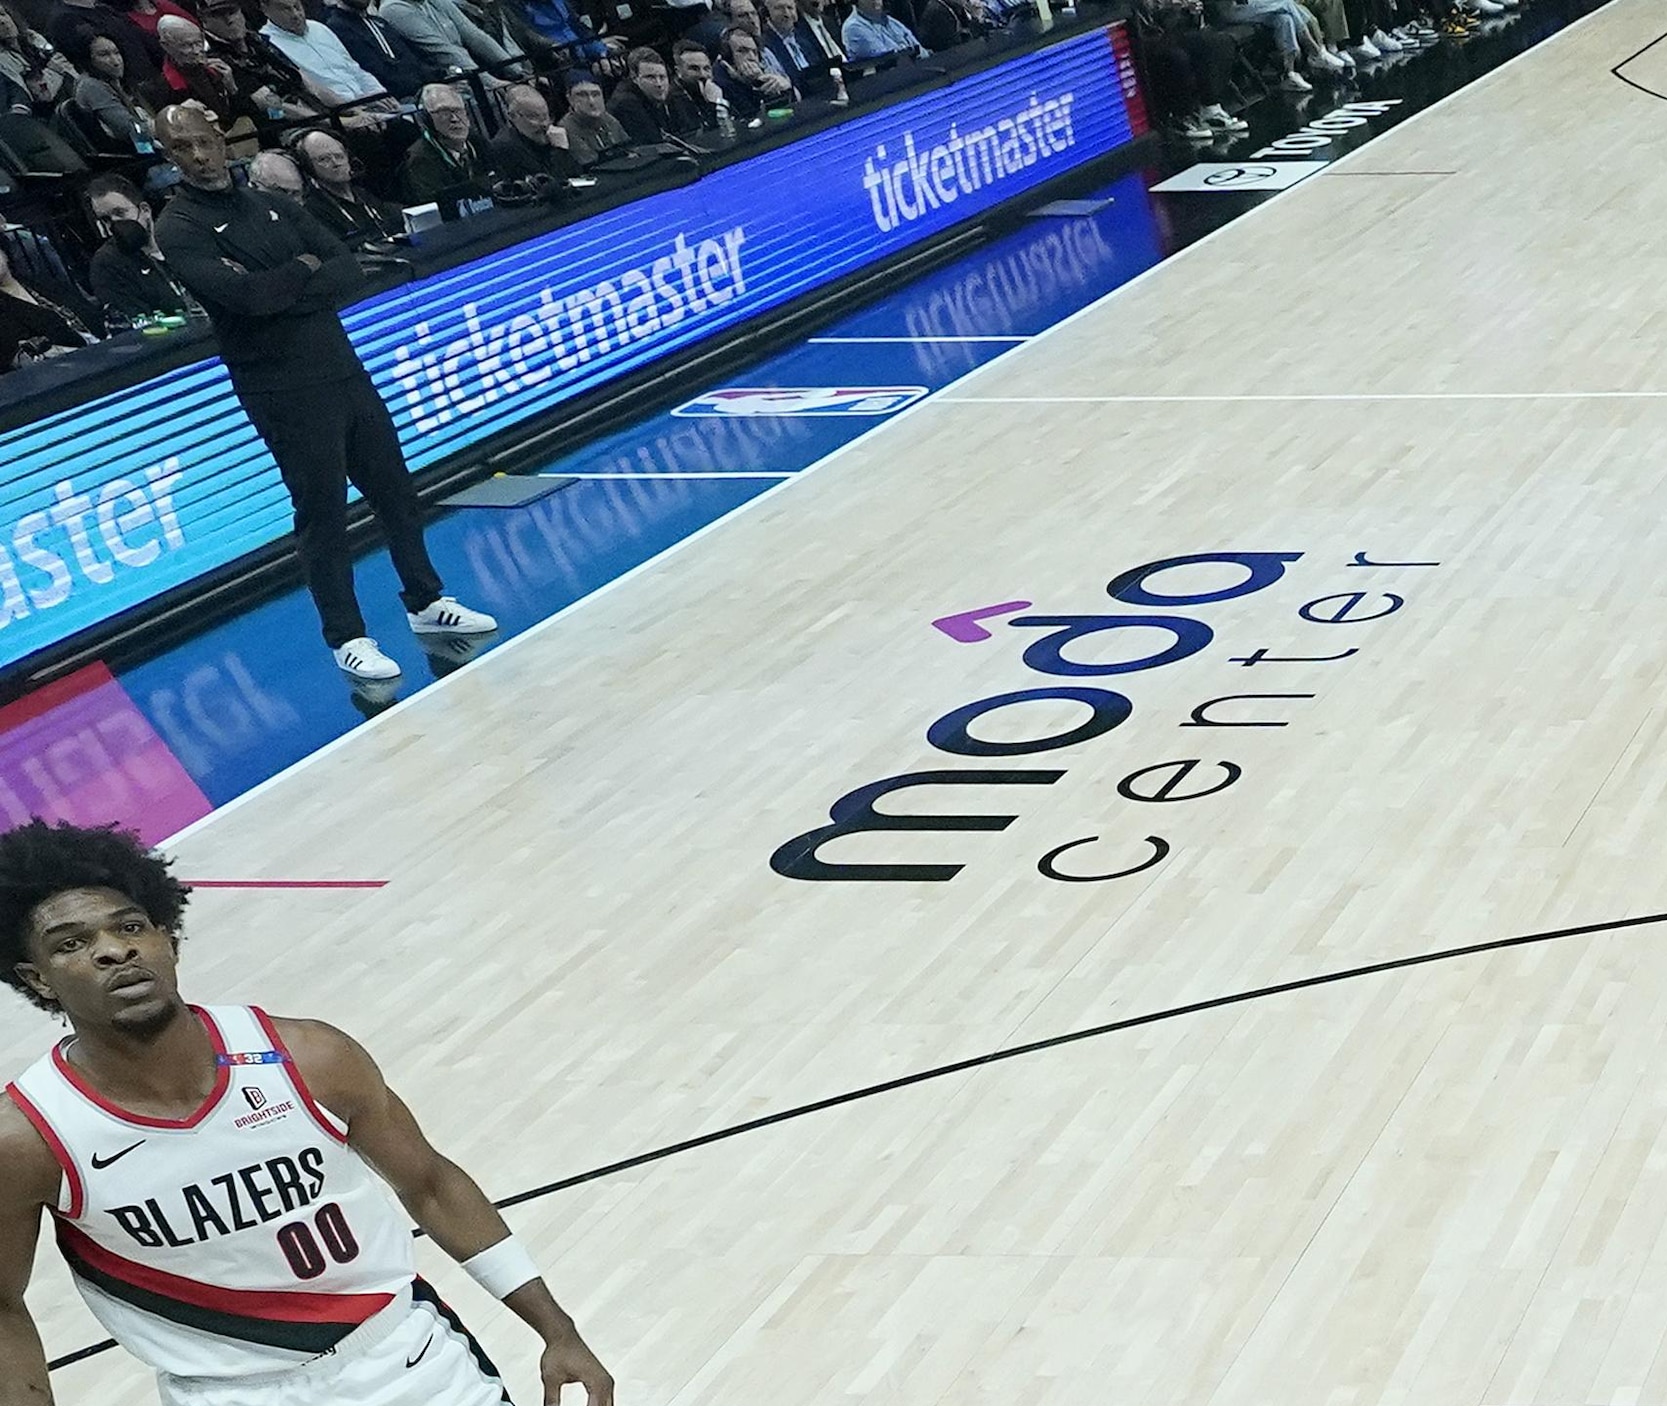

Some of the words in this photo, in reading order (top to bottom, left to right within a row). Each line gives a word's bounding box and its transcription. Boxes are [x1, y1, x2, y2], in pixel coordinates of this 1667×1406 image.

[863, 91, 1075, 233] ticketmaster
[1250, 99, 1403, 159] TOYOTA
[391, 227, 746, 435] ticketmaster
[769, 552, 1305, 882] moda
[1037, 551, 1441, 882] center
[244, 1053, 263, 1064] 32
[234, 1101, 295, 1128] BRIGHTSIDE
[104, 1147, 325, 1248] BLAZERS
[277, 1202, 359, 1280] 00
